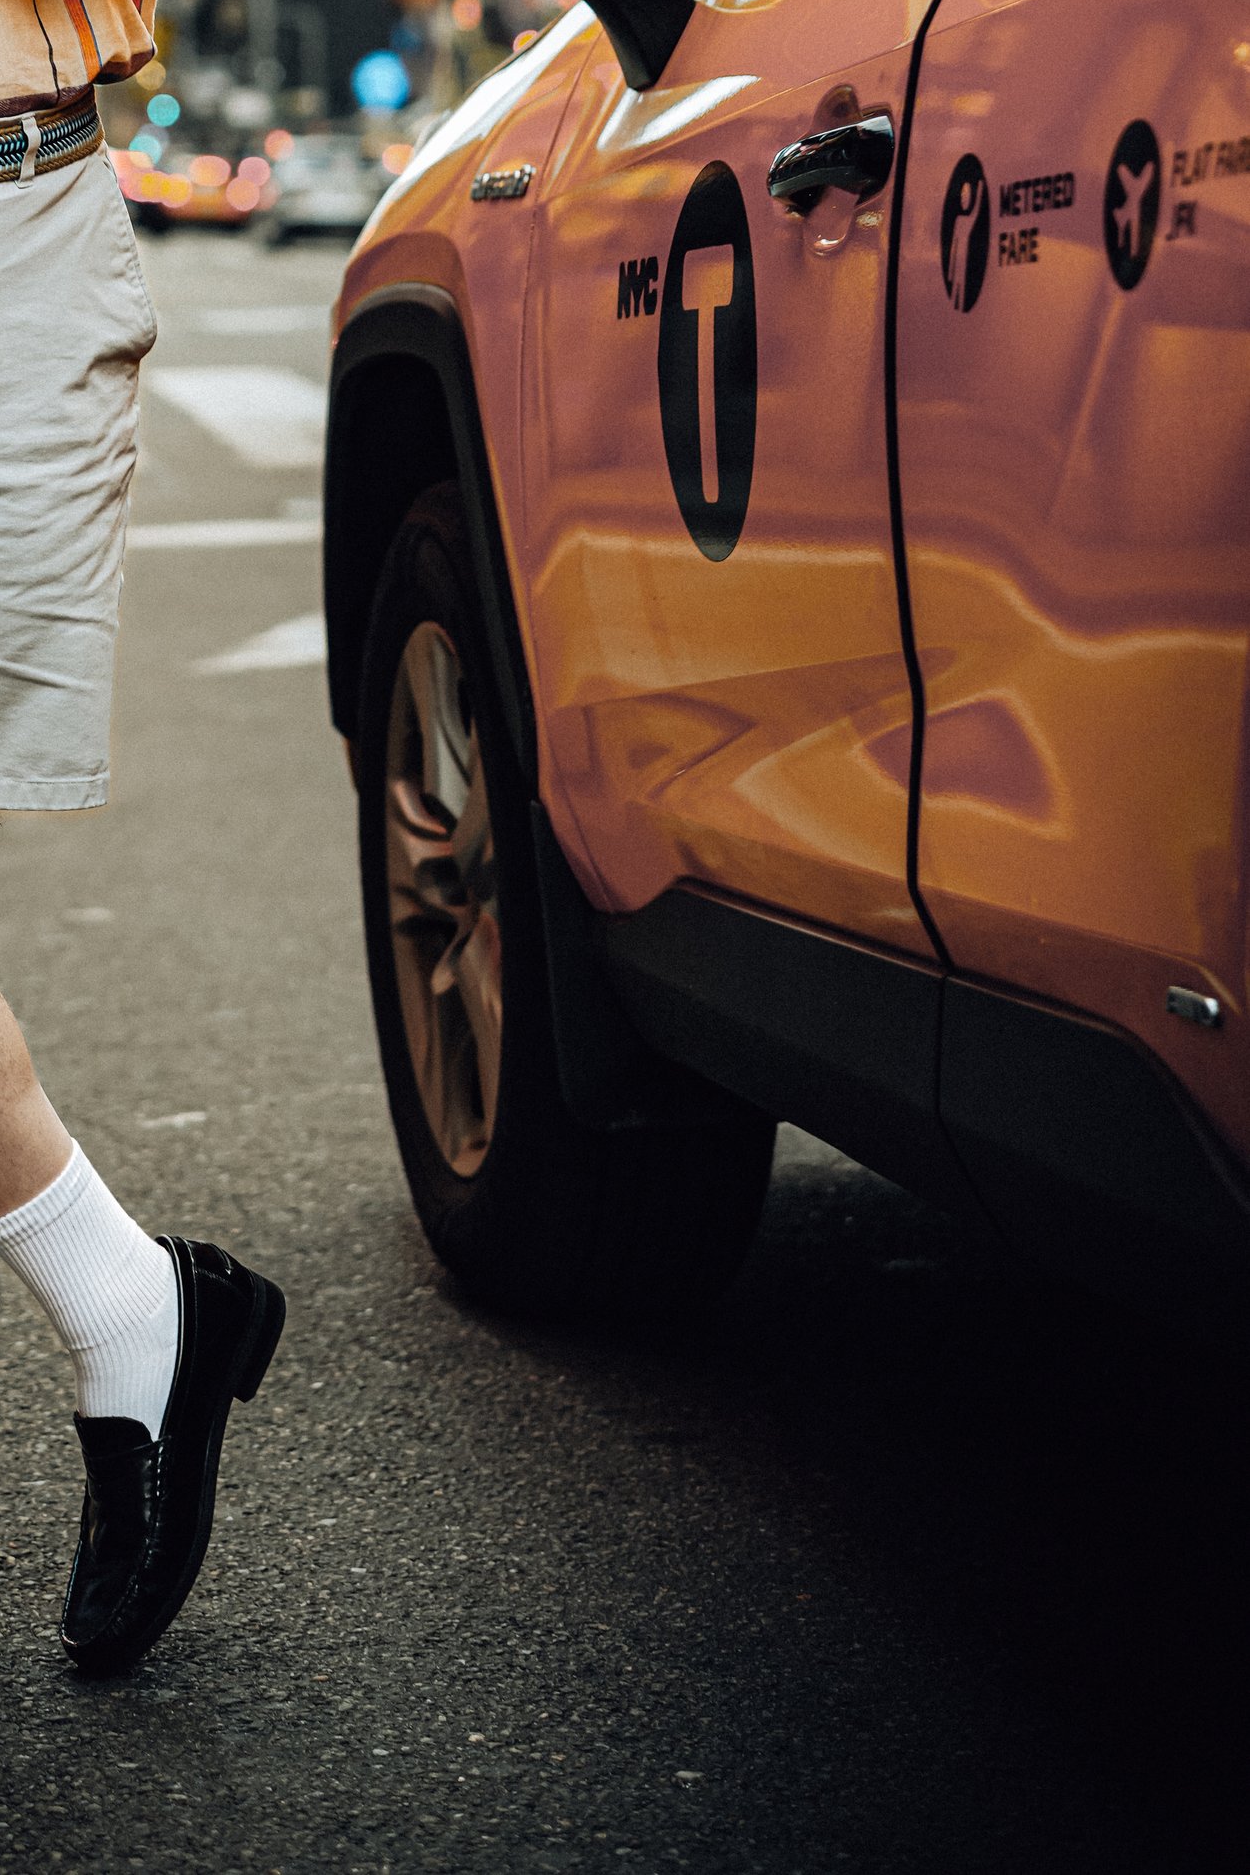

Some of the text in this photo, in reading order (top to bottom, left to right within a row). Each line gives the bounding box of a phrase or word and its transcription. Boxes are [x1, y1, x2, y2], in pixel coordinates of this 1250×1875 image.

[998, 171, 1075, 219] METERED
[997, 227, 1040, 267] FARE
[617, 255, 660, 320] NYC
